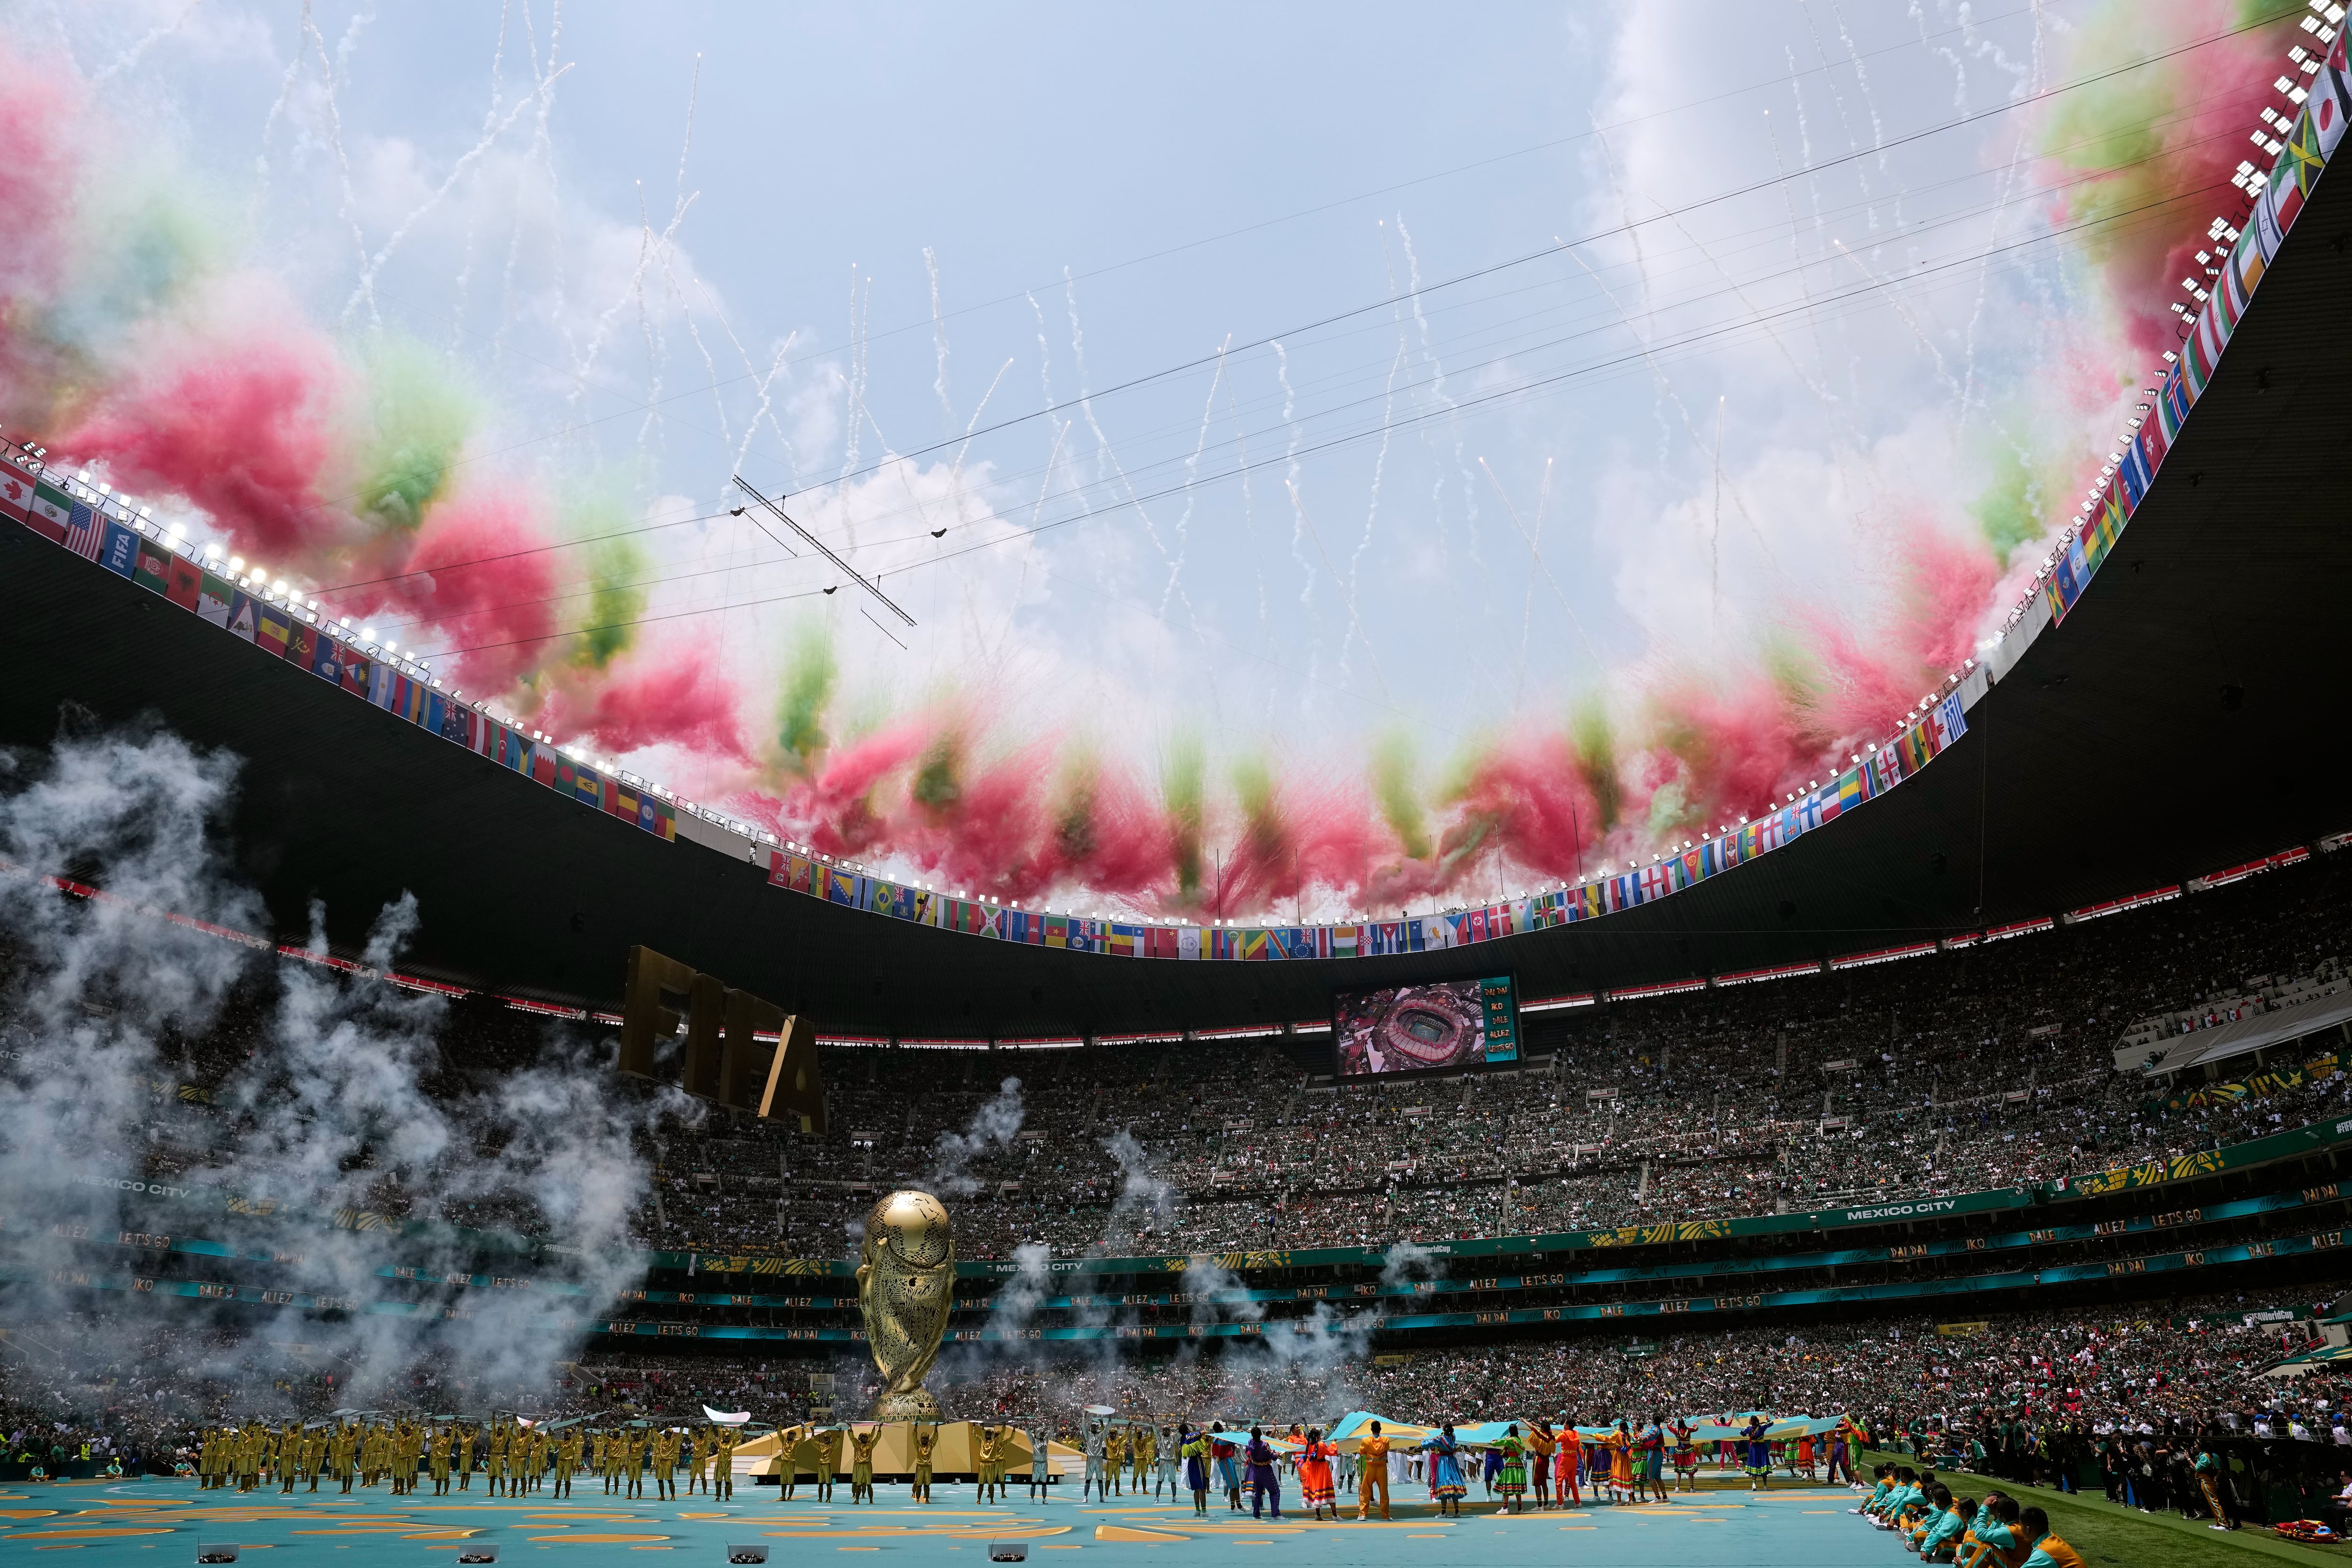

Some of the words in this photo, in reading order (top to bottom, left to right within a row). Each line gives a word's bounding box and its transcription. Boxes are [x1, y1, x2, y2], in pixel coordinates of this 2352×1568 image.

[112, 533, 130, 569] FIFA
[1490, 1029, 1510, 1038] ALLEZ
[618, 945, 827, 1138] FIFA
[2336, 1119, 2352, 1134] #FIFA
[72, 1174, 146, 1192] MEXICO
[149, 1184, 191, 1199] CITY
[2303, 1188, 2320, 1202] DAI
[2320, 1184, 2339, 1200] DAI
[1847, 1205, 1913, 1220] MEXICO
[1916, 1200, 1956, 1213] CITY
[2152, 1210, 2184, 1227] LET'S
[2185, 1208, 2201, 1222] GO
[52, 1223, 89, 1239] ALLEZ
[2093, 1220, 2127, 1236] ALLEZ
[118, 1231, 151, 1246] LET'S
[154, 1235, 170, 1248] GO
[2029, 1229, 2056, 1243] DALE
[2311, 1231, 2344, 1250] ALLEZ
[1966, 1237, 1985, 1250] IKO
[1404, 1245, 1451, 1255] #FIFAWorldCup
[1891, 1247, 1907, 1258] DAI
[1910, 1244, 1928, 1256] DAI
[2247, 1242, 2275, 1258] DALE
[2185, 1252, 2205, 1266] IKO
[395, 1266, 416, 1279] DALE
[996, 1263, 1049, 1272] MEXIO
[1051, 1262, 1083, 1271] CITY
[2107, 1263, 2125, 1275] DAI
[2127, 1259, 2145, 1273] DAI
[133, 1278, 153, 1291] IKO
[446, 1272, 471, 1285] ALLEZ
[492, 1276, 516, 1289] LET'S
[518, 1279, 531, 1289] GO
[1469, 1278, 1498, 1290] ALLEZ
[1520, 1274, 1548, 1287] LET'S
[1550, 1274, 1564, 1285] GO
[199, 1285, 223, 1298] DALE
[1296, 1288, 1311, 1298] DAI
[1313, 1288, 1327, 1298] DAI
[1414, 1281, 1436, 1293] DALE
[261, 1290, 293, 1305] ALLEZ
[617, 1289, 630, 1299] DAI
[633, 1290, 647, 1301] DAI
[679, 1292, 695, 1303] IKO
[731, 1295, 753, 1306] DALE
[1121, 1294, 1148, 1305] ALLEZ
[1169, 1293, 1194, 1304] LET'S
[1196, 1292, 1209, 1303] GO
[316, 1296, 342, 1309] LET'S
[345, 1299, 359, 1310] GO
[784, 1297, 811, 1308] ALLEZ
[833, 1297, 859, 1308] LET'S
[960, 1298, 974, 1309] DAI
[1071, 1296, 1092, 1307] DALE
[1660, 1301, 1690, 1314] ALLEZ
[1714, 1296, 1743, 1310] LET'S
[1745, 1295, 1761, 1307] GO
[1476, 1313, 1491, 1324] DAI
[1494, 1312, 1509, 1323] DAI
[1543, 1309, 1561, 1321] IKO
[1600, 1306, 1624, 1318] DALE
[2247, 1310, 2294, 1321] IFAWorldCup
[608, 1322, 636, 1334] ALLEZ
[1240, 1324, 1262, 1335] DALE
[1343, 1319, 1368, 1330] LET'S
[1371, 1318, 1385, 1329] GO
[658, 1325, 683, 1336] LET'S
[685, 1326, 699, 1336] GO
[787, 1329, 802, 1340] DAI
[803, 1329, 818, 1340] DAI
[850, 1330, 866, 1340] IKO
[954, 1330, 981, 1341] ALLEZ
[1002, 1329, 1026, 1340] LET'S
[1029, 1329, 1041, 1339] GO
[1127, 1328, 1140, 1337] DAI
[1143, 1327, 1157, 1337] DAI
[1188, 1326, 1204, 1336] IKO
